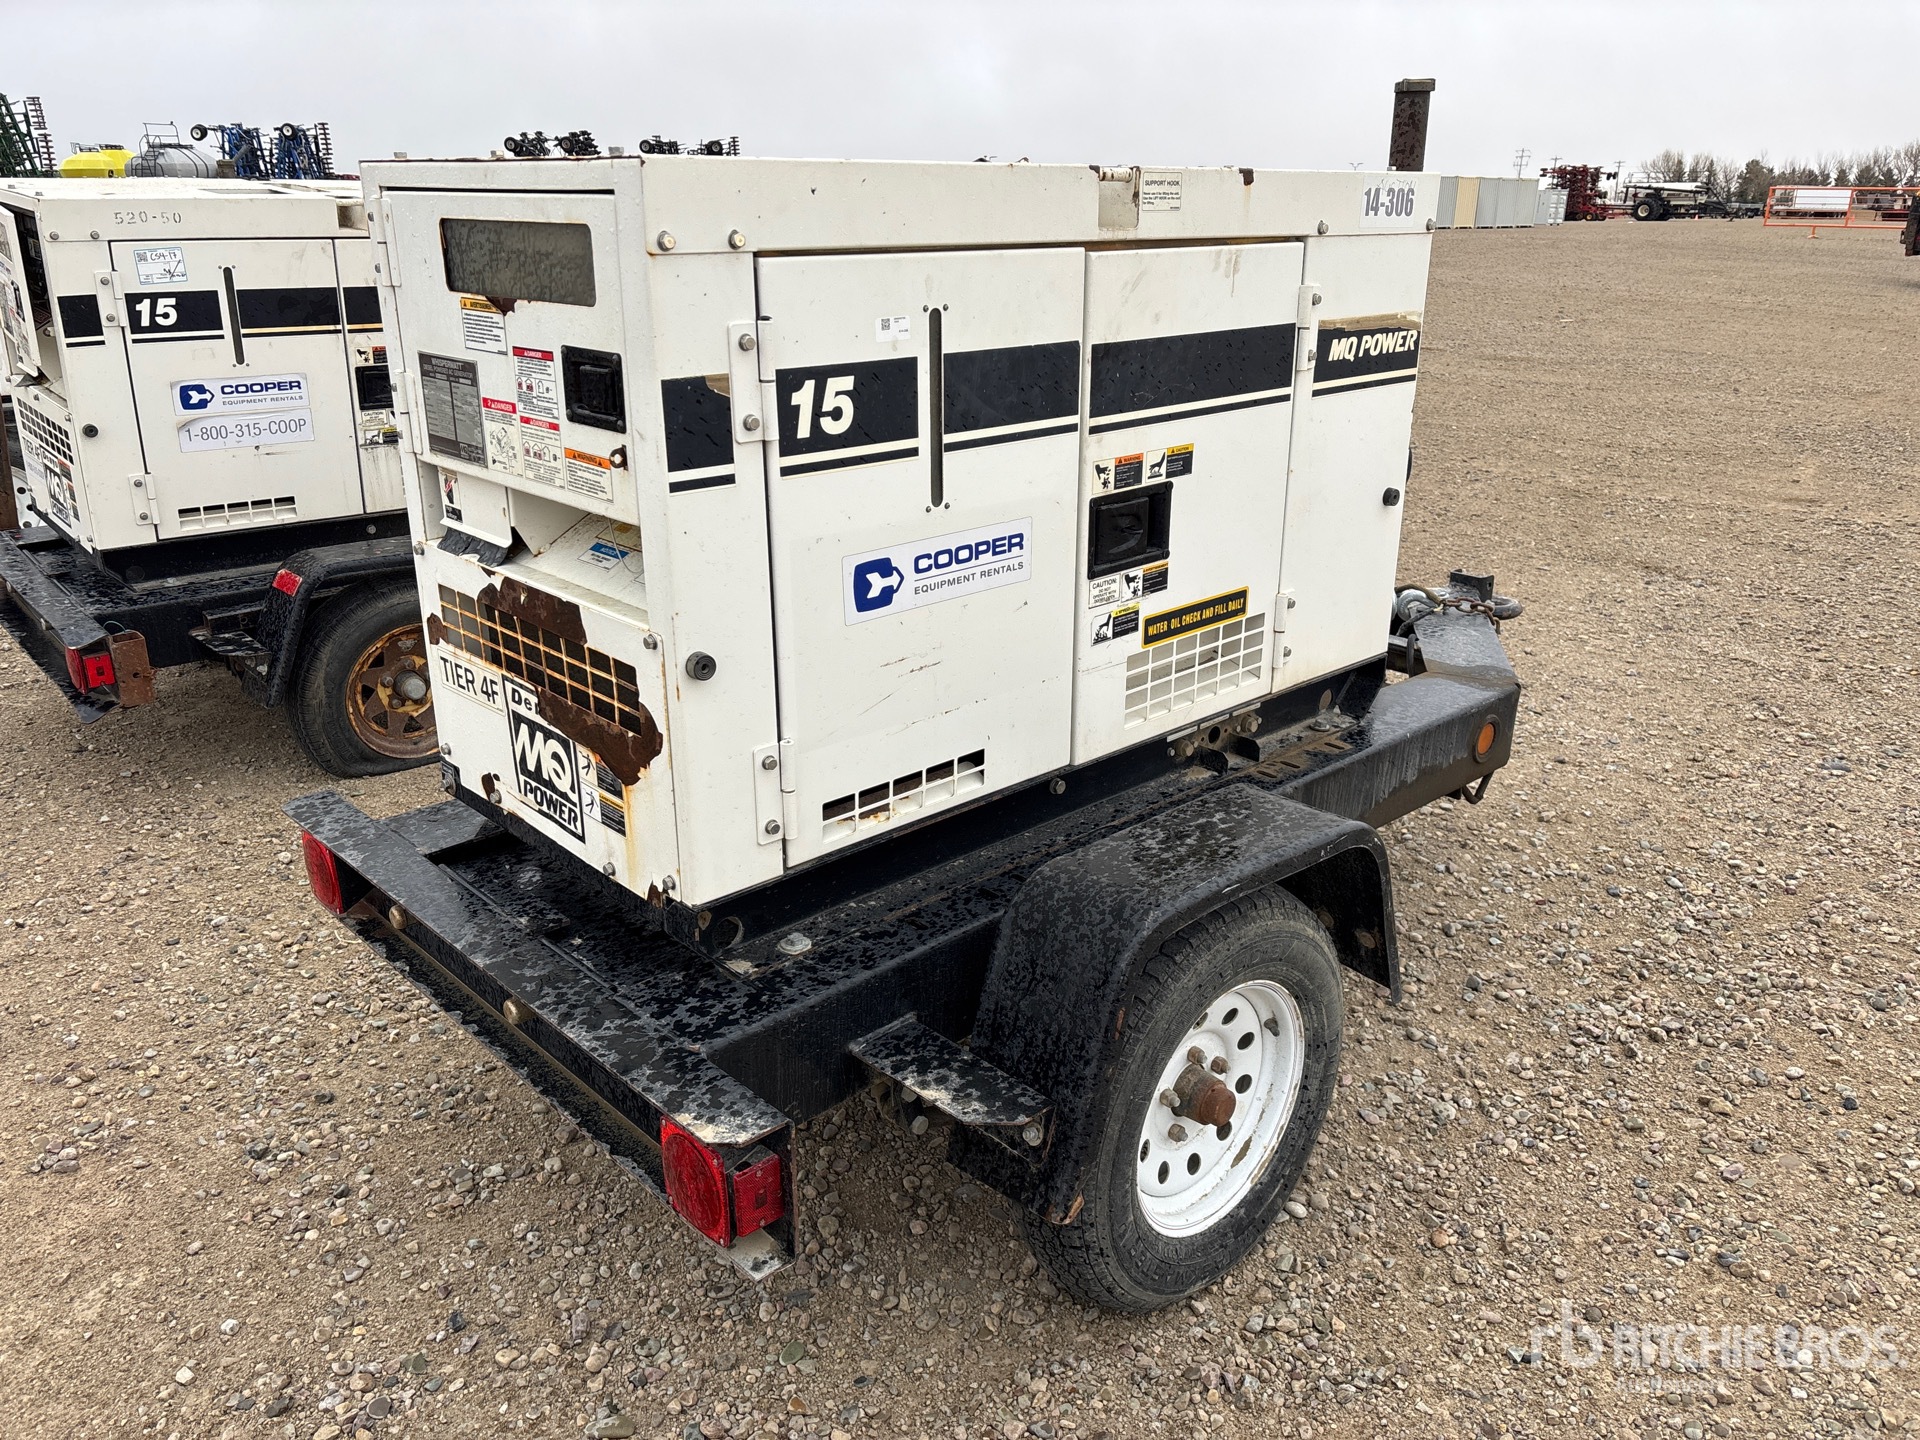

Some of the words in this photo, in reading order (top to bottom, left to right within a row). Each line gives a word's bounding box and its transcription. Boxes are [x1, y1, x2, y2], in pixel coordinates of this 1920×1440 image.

[1364, 187, 1415, 217] 14-306
[114, 211, 181, 225] 520-50
[135, 298, 178, 327] 15
[1328, 336, 1358, 362] MQ
[1358, 329, 1418, 357] POWER
[220, 380, 302, 395] COOPER
[222, 398, 268, 406] EQUIPMENT
[494, 401, 513, 412] DANGER
[790, 375, 855, 440] 15
[185, 418, 307, 442] 1-800-315-COOP
[914, 532, 1024, 574] COOPER
[914, 573, 976, 596] EQUIPMENT
[979, 561, 1024, 580] RENTALS
[1092, 577, 1117, 590] CAUTION:
[1170, 618, 1181, 630] OIL
[1182, 612, 1201, 627] CHECK
[1202, 609, 1214, 620] AND
[1214, 605, 1227, 617] FILL
[1228, 598, 1245, 614] DAILY
[440, 655, 478, 696] TIER
[480, 675, 499, 705] 4F
[516, 722, 577, 806] MQ
[523, 780, 579, 832] POWER
